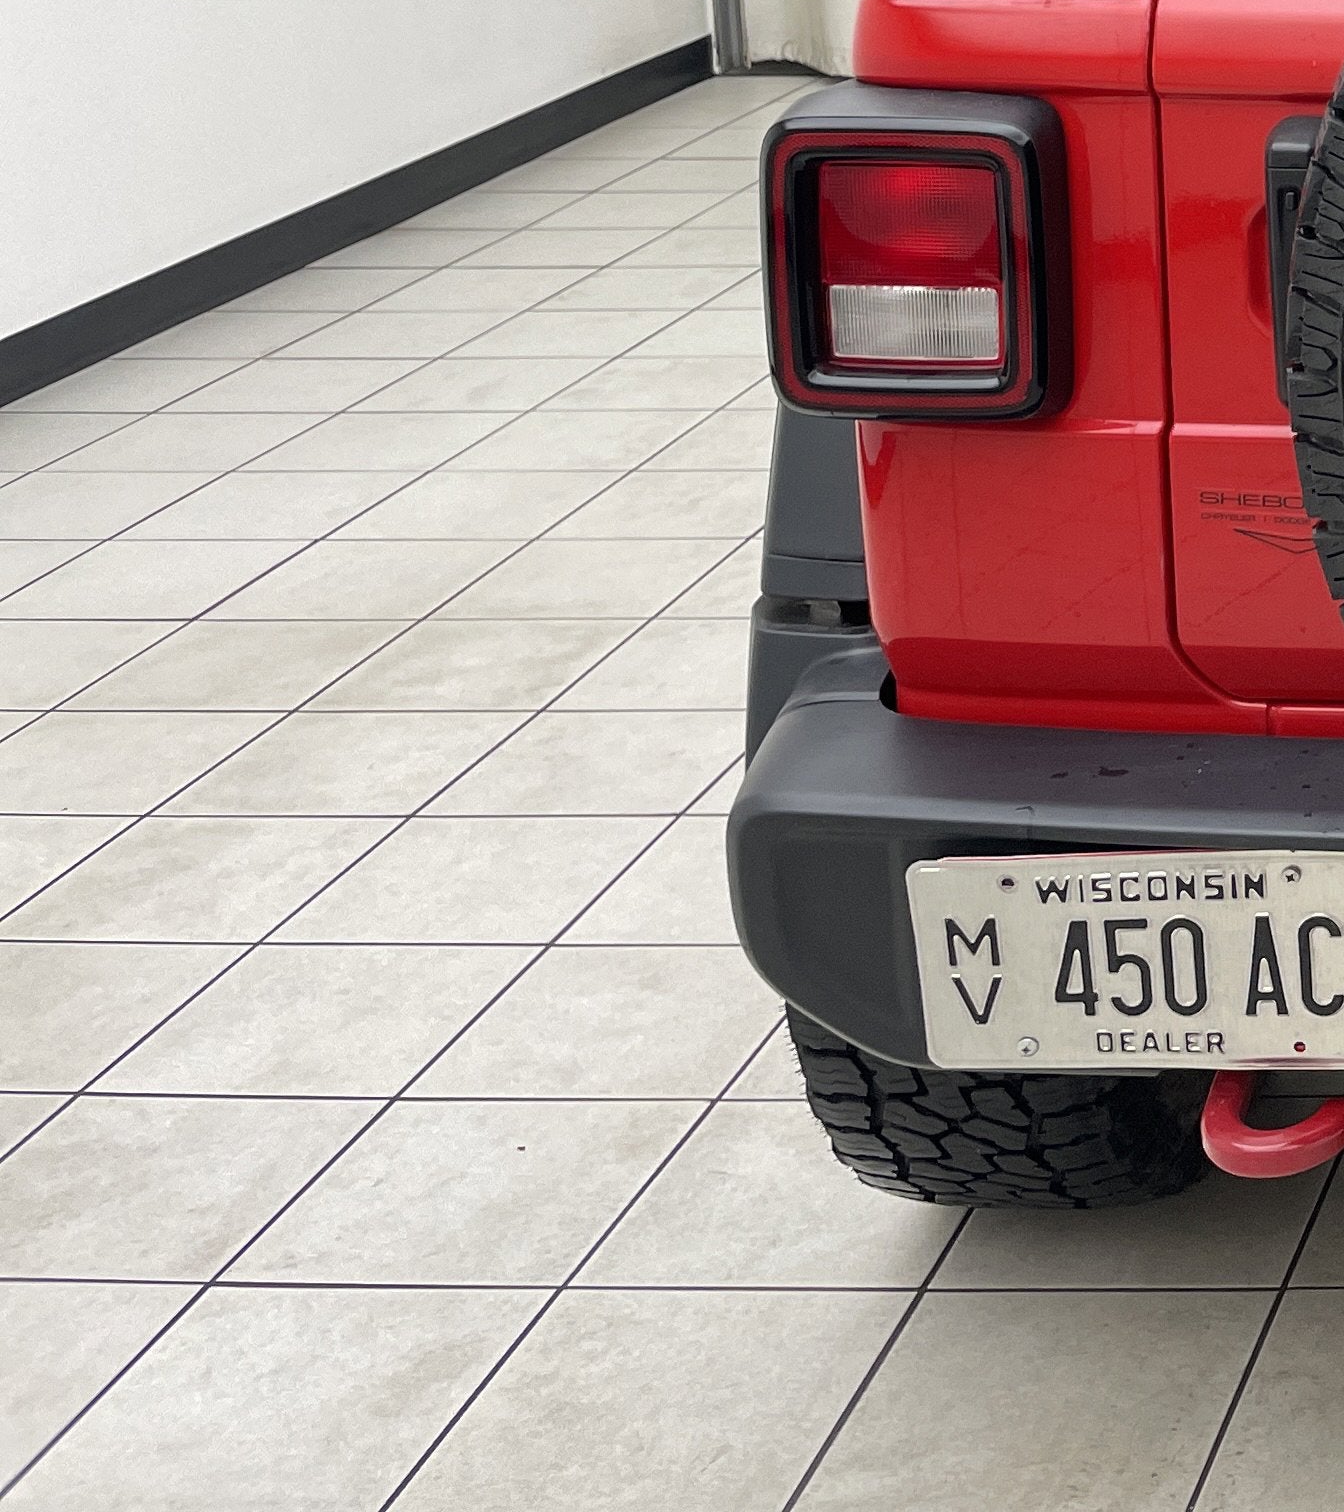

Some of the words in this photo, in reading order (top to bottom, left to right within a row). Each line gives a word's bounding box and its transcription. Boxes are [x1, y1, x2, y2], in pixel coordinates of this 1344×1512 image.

[1035, 871, 1267, 904] WISCONSIN
[1054, 916, 1208, 1017] 450
[1245, 912, 1344, 1017] AC
[1096, 1031, 1226, 1054] DEALER
